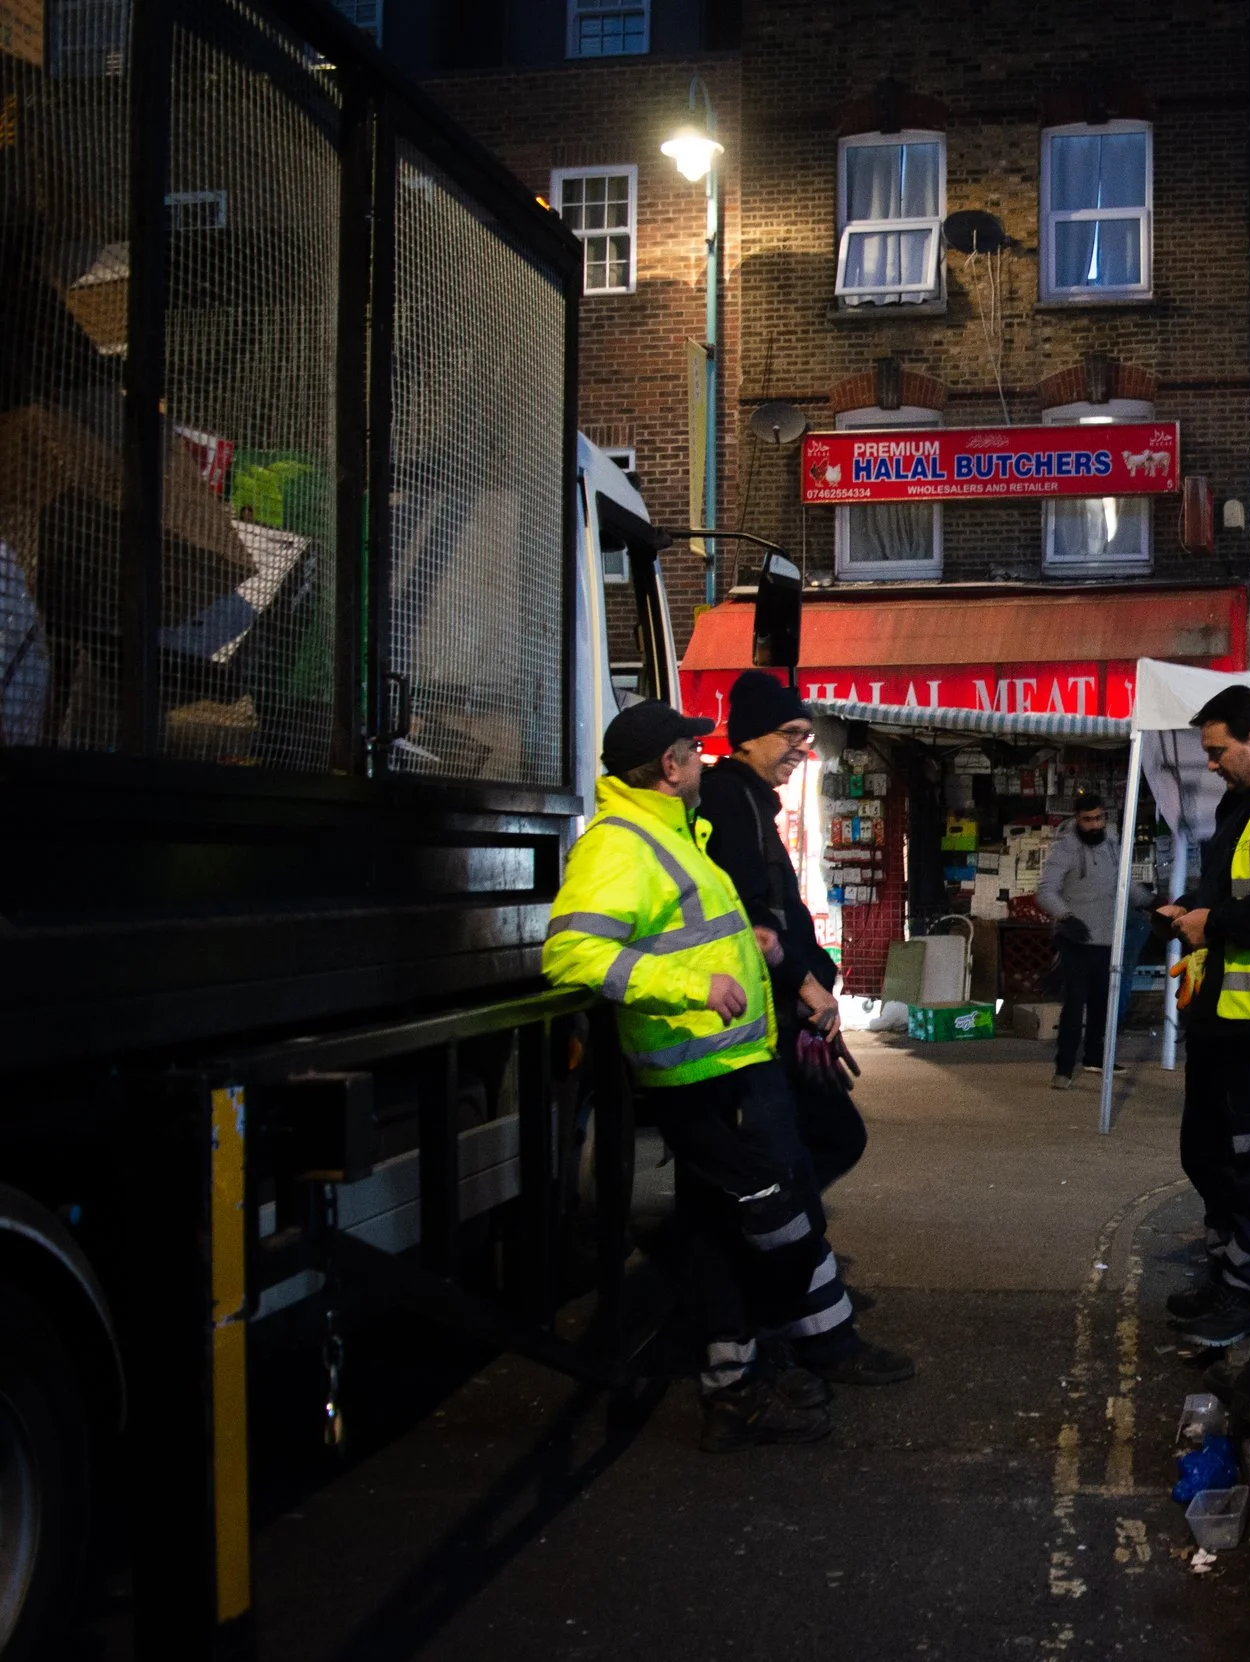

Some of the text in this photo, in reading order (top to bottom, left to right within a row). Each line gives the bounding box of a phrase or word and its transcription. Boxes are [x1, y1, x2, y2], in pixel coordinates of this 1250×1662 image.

[853, 440, 940, 457] PREMIUM
[852, 450, 1113, 483] HALAL BUTCHERS
[806, 488, 871, 499] 07462554334
[907, 481, 1059, 495] WHOLESALERS AND RETAILER
